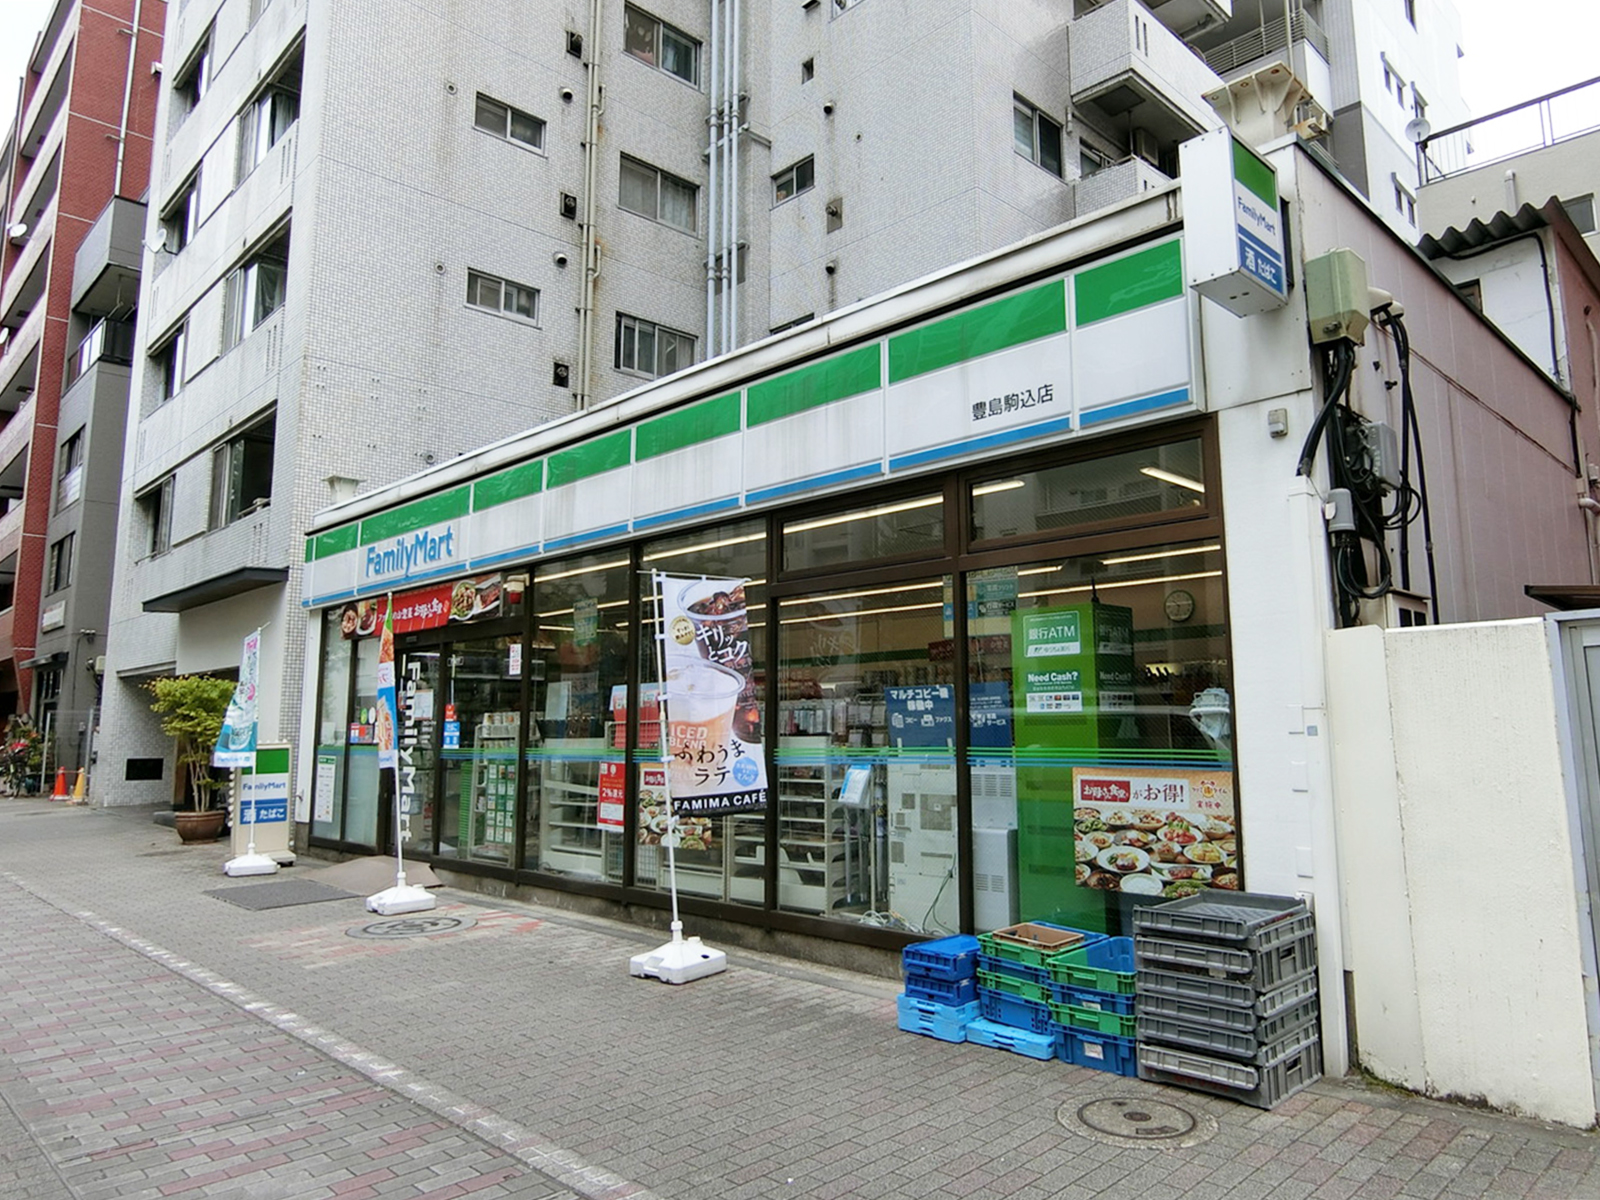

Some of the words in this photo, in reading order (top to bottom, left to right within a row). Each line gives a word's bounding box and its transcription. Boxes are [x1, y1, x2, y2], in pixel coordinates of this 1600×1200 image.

[1238, 197, 1276, 236] FamilyMart
[1245, 247, 1256, 272] 酒
[1257, 258, 1278, 285] たばこ
[972, 384, 1054, 421] 豊島駒込店
[366, 526, 453, 576] FamilyMart
[696, 625, 734, 648] キリッ
[1028, 625, 1075, 640] 銀行ATM
[708, 640, 748, 664] とコク
[1028, 674, 1049, 682] Need
[1051, 671, 1078, 680] Cash?
[671, 725, 708, 739] ICED
[400, 661, 421, 842] FamilyMart
[674, 739, 746, 766] ふわうま
[242, 782, 286, 791] FamilyMart
[695, 766, 730, 786] ラテ
[674, 797, 730, 811] FAMIMA
[733, 789, 767, 806] CAFÉ
[259, 808, 285, 820] たばこ
